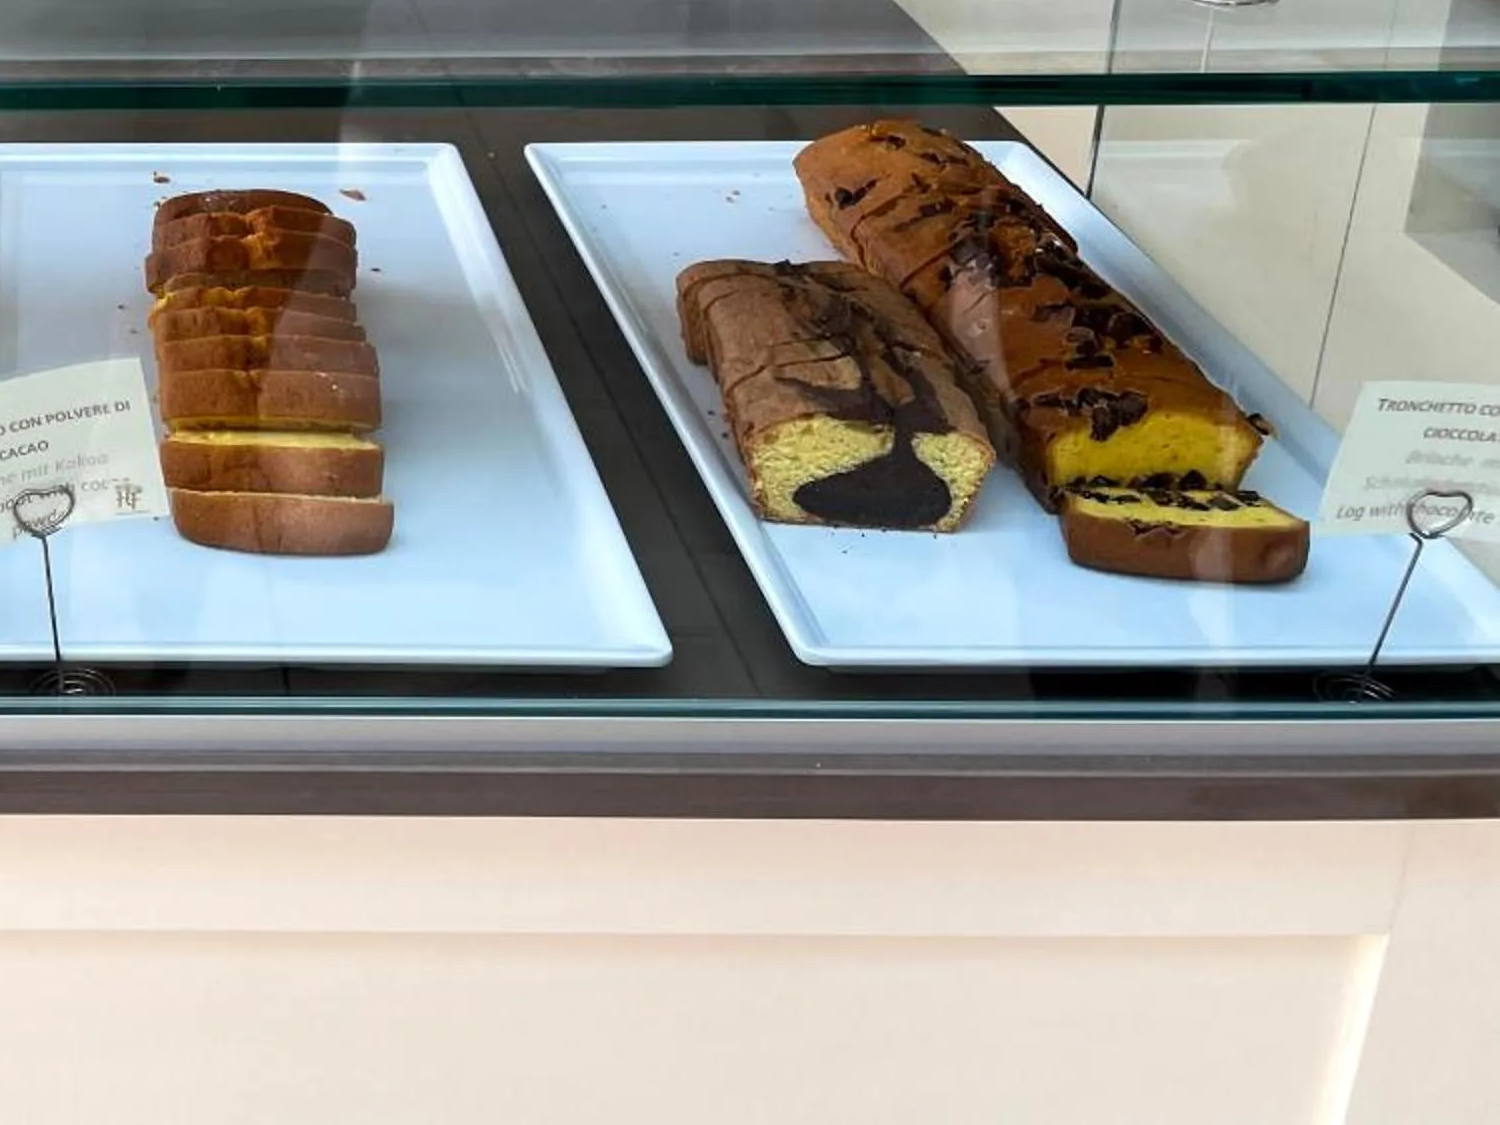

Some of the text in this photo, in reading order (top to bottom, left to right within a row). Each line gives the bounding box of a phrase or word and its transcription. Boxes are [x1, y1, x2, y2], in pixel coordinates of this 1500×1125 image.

[1377, 398, 1477, 415] TRONCHETTO
[9, 415, 43, 434] CON
[45, 404, 111, 425] POLVERE
[114, 400, 131, 413] DI
[1423, 427, 1500, 443] CIOCCOLA
[1336, 505, 1366, 521] Log
